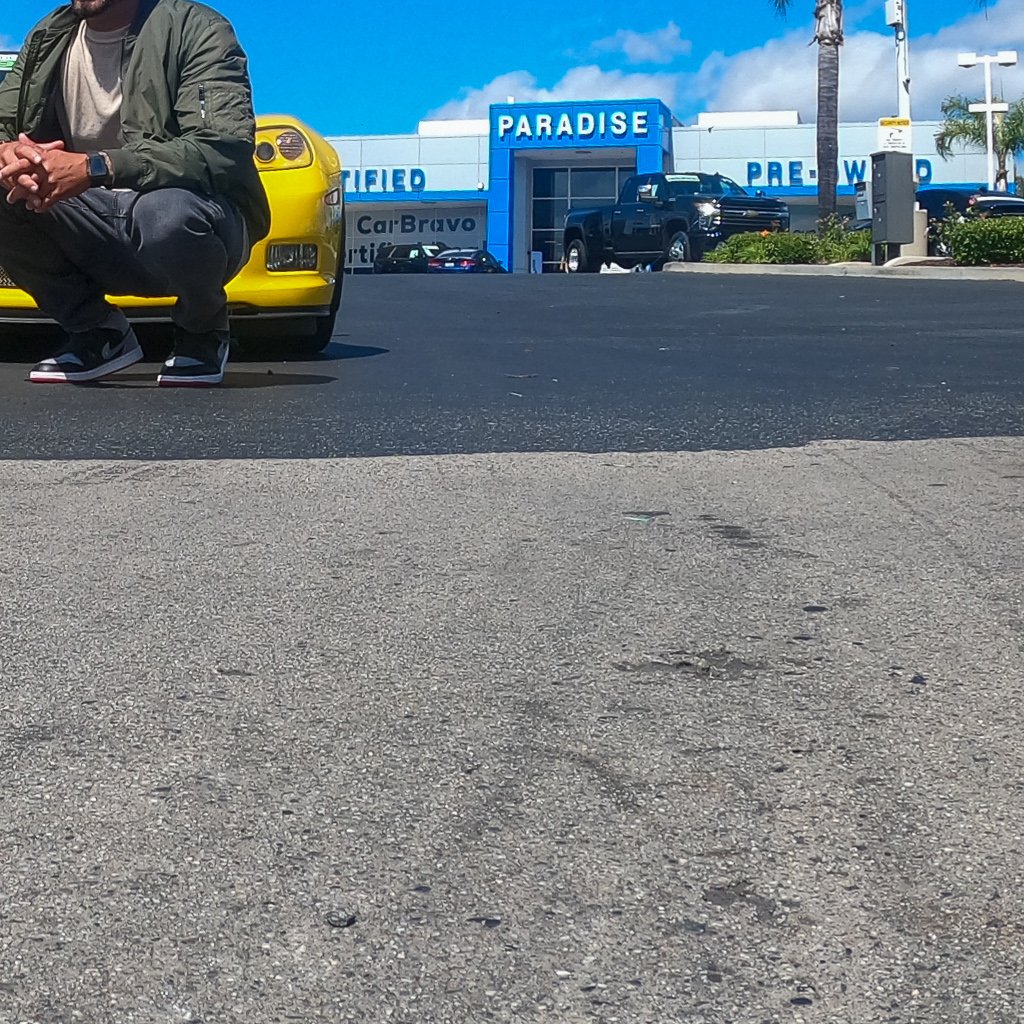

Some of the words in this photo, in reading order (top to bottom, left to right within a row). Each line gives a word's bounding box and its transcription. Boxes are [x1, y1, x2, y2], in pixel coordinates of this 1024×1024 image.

[498, 111, 648, 140] PARADISE
[341, 167, 426, 193] TIFIED
[747, 158, 933, 188] PRE-WD
[356, 214, 476, 235] CarBravo
